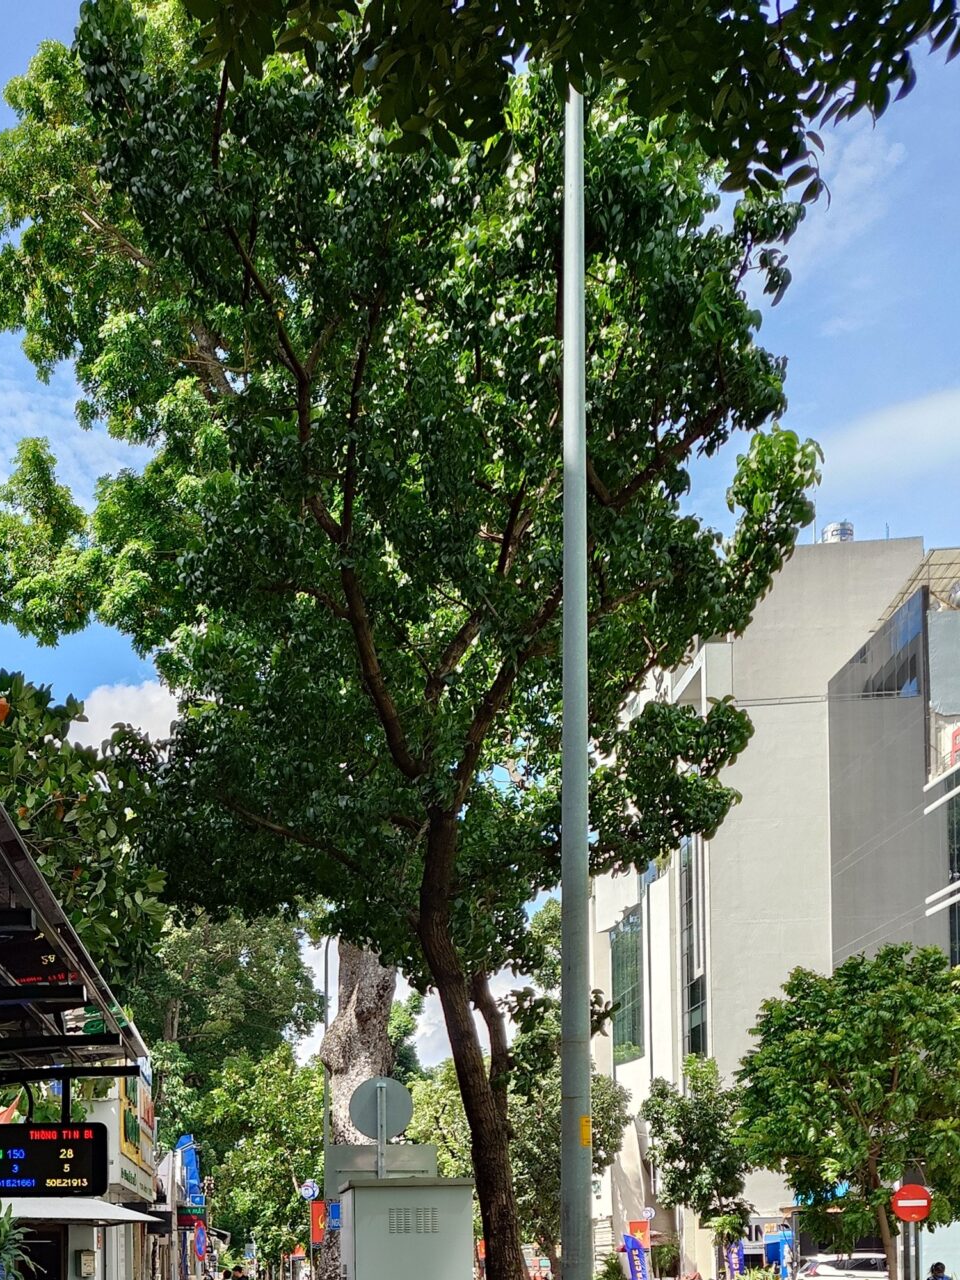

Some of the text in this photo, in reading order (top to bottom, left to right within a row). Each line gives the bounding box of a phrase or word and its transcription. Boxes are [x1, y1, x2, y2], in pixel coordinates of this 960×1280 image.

[29, 1130, 57, 1140] THÔNG
[62, 1130, 80, 1140] TIN
[6, 1149, 25, 1159] 150
[59, 1149, 74, 1159] 28
[12, 1164, 19, 1173] 3
[63, 1164, 70, 1173] 5
